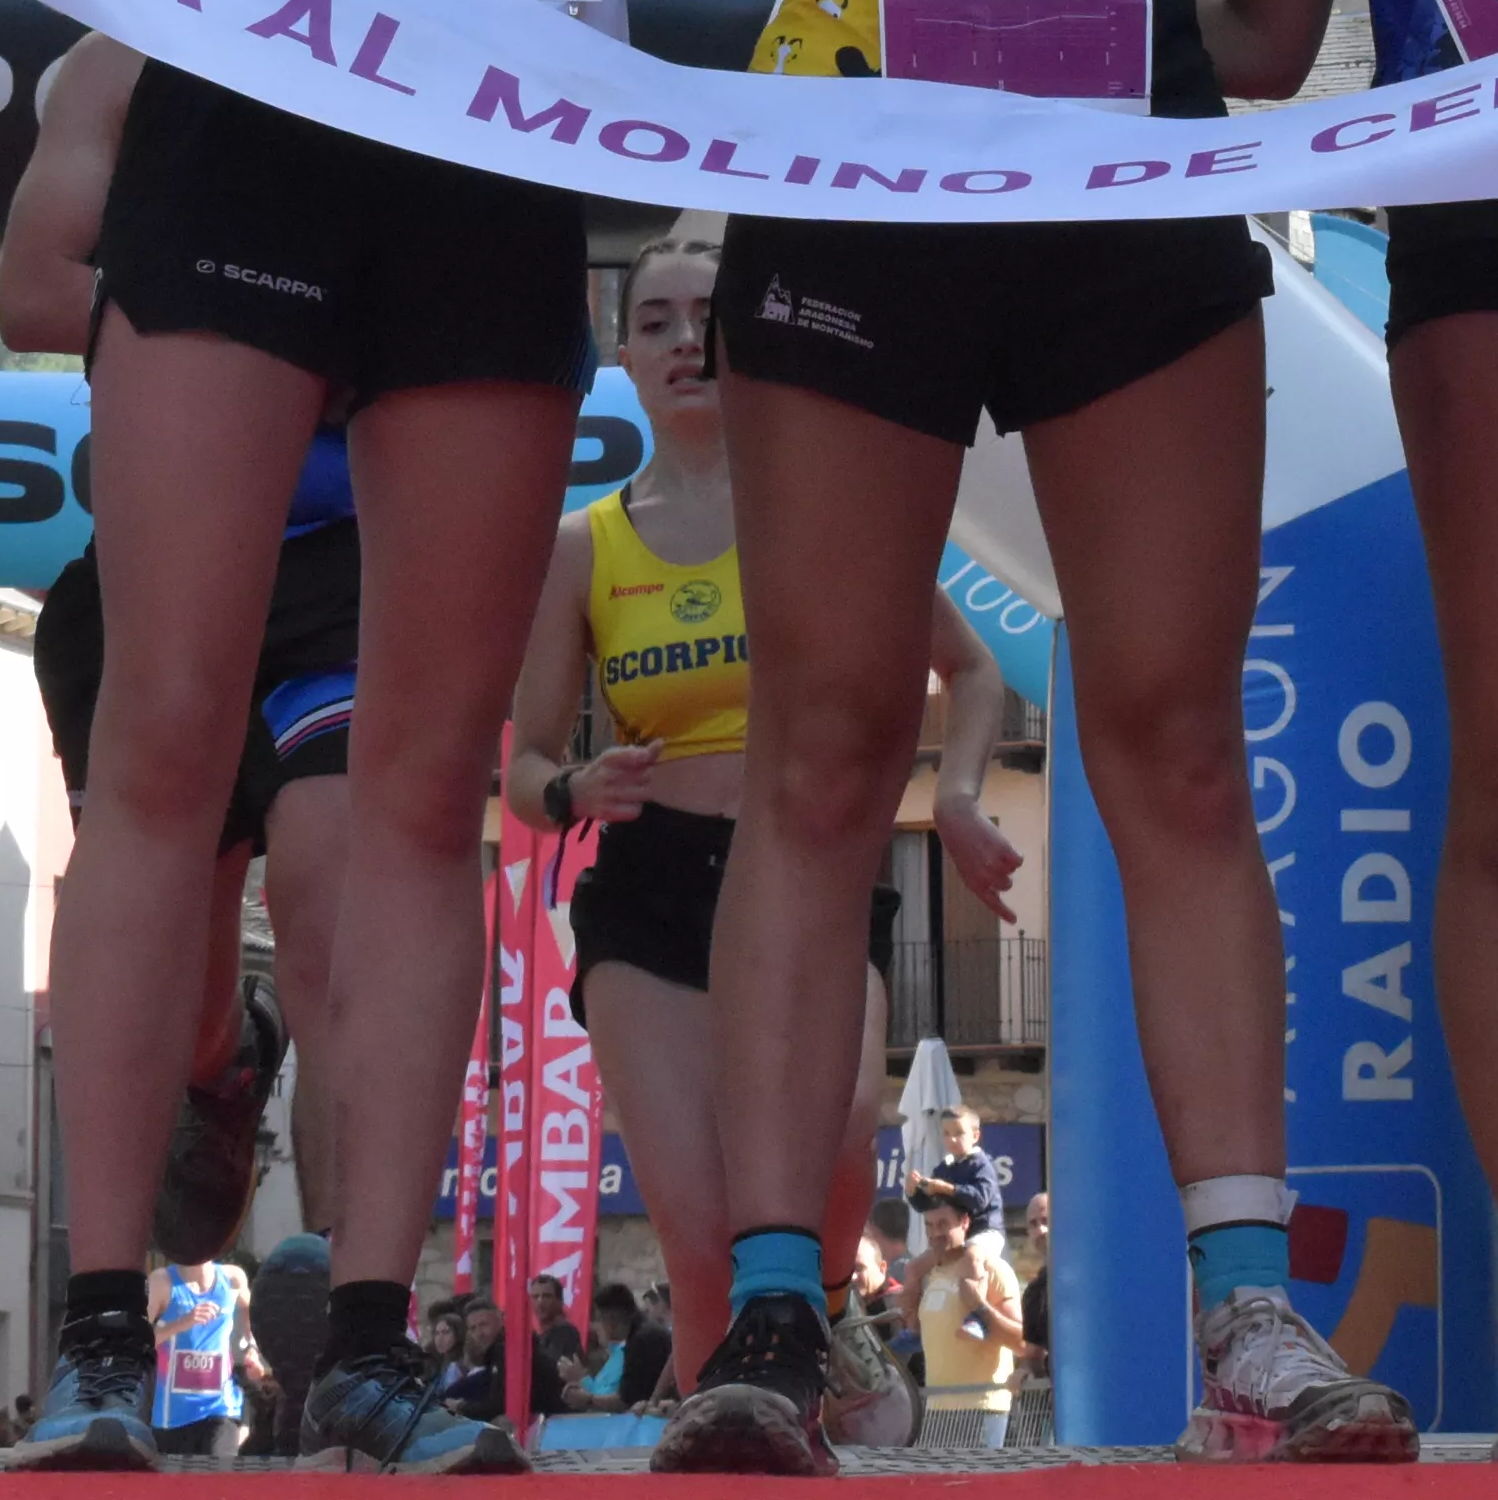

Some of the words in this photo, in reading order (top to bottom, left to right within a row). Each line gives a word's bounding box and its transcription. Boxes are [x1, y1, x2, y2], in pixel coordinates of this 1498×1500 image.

[465, 64, 1033, 194] MOLINO
[1085, 141, 1262, 190] DE
[224, 264, 323, 301] SCARPA
[1338, 701, 1413, 1102] RADIO
[183, 1355, 215, 1369] 6001
